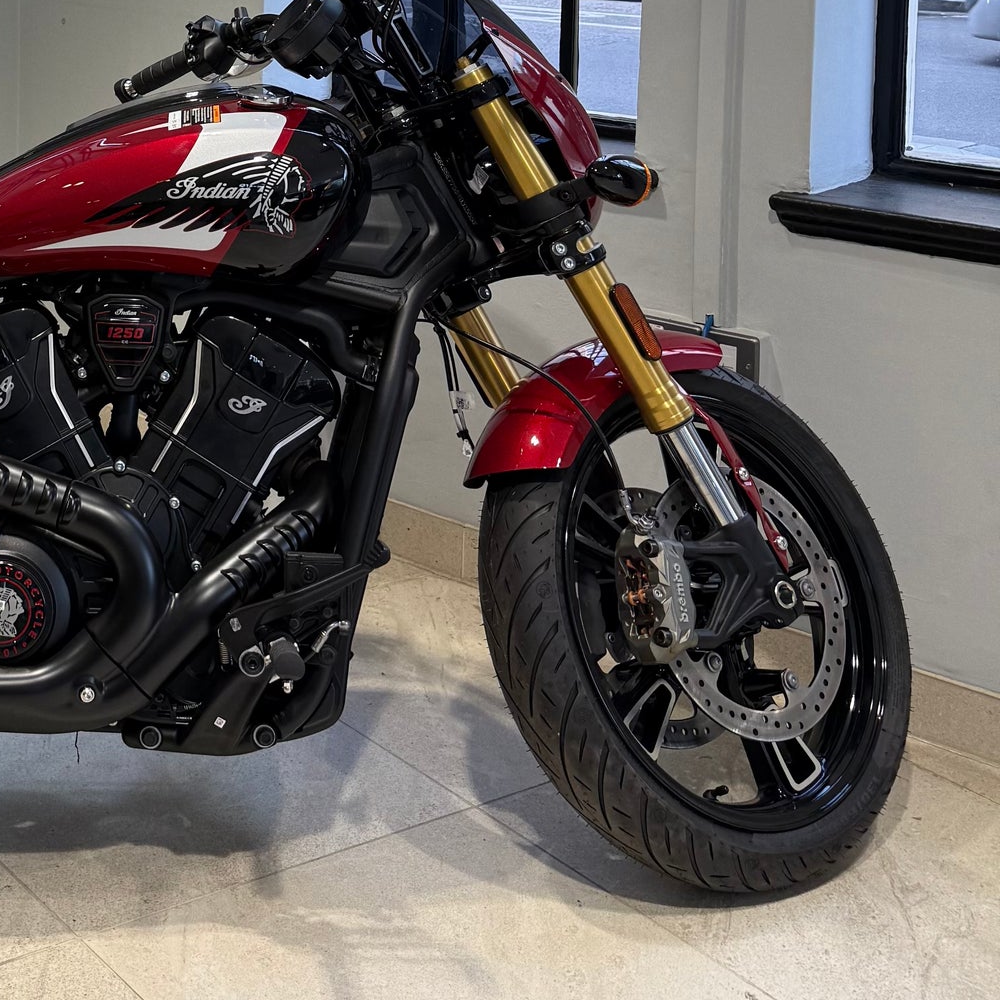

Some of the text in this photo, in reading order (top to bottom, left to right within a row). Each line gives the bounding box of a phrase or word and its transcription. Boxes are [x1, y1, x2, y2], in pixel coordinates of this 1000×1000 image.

[166, 177, 251, 200] Indian
[114, 308, 138, 316] Indian
[107, 327, 145, 339] 1250
[673, 563, 689, 622] brembo
